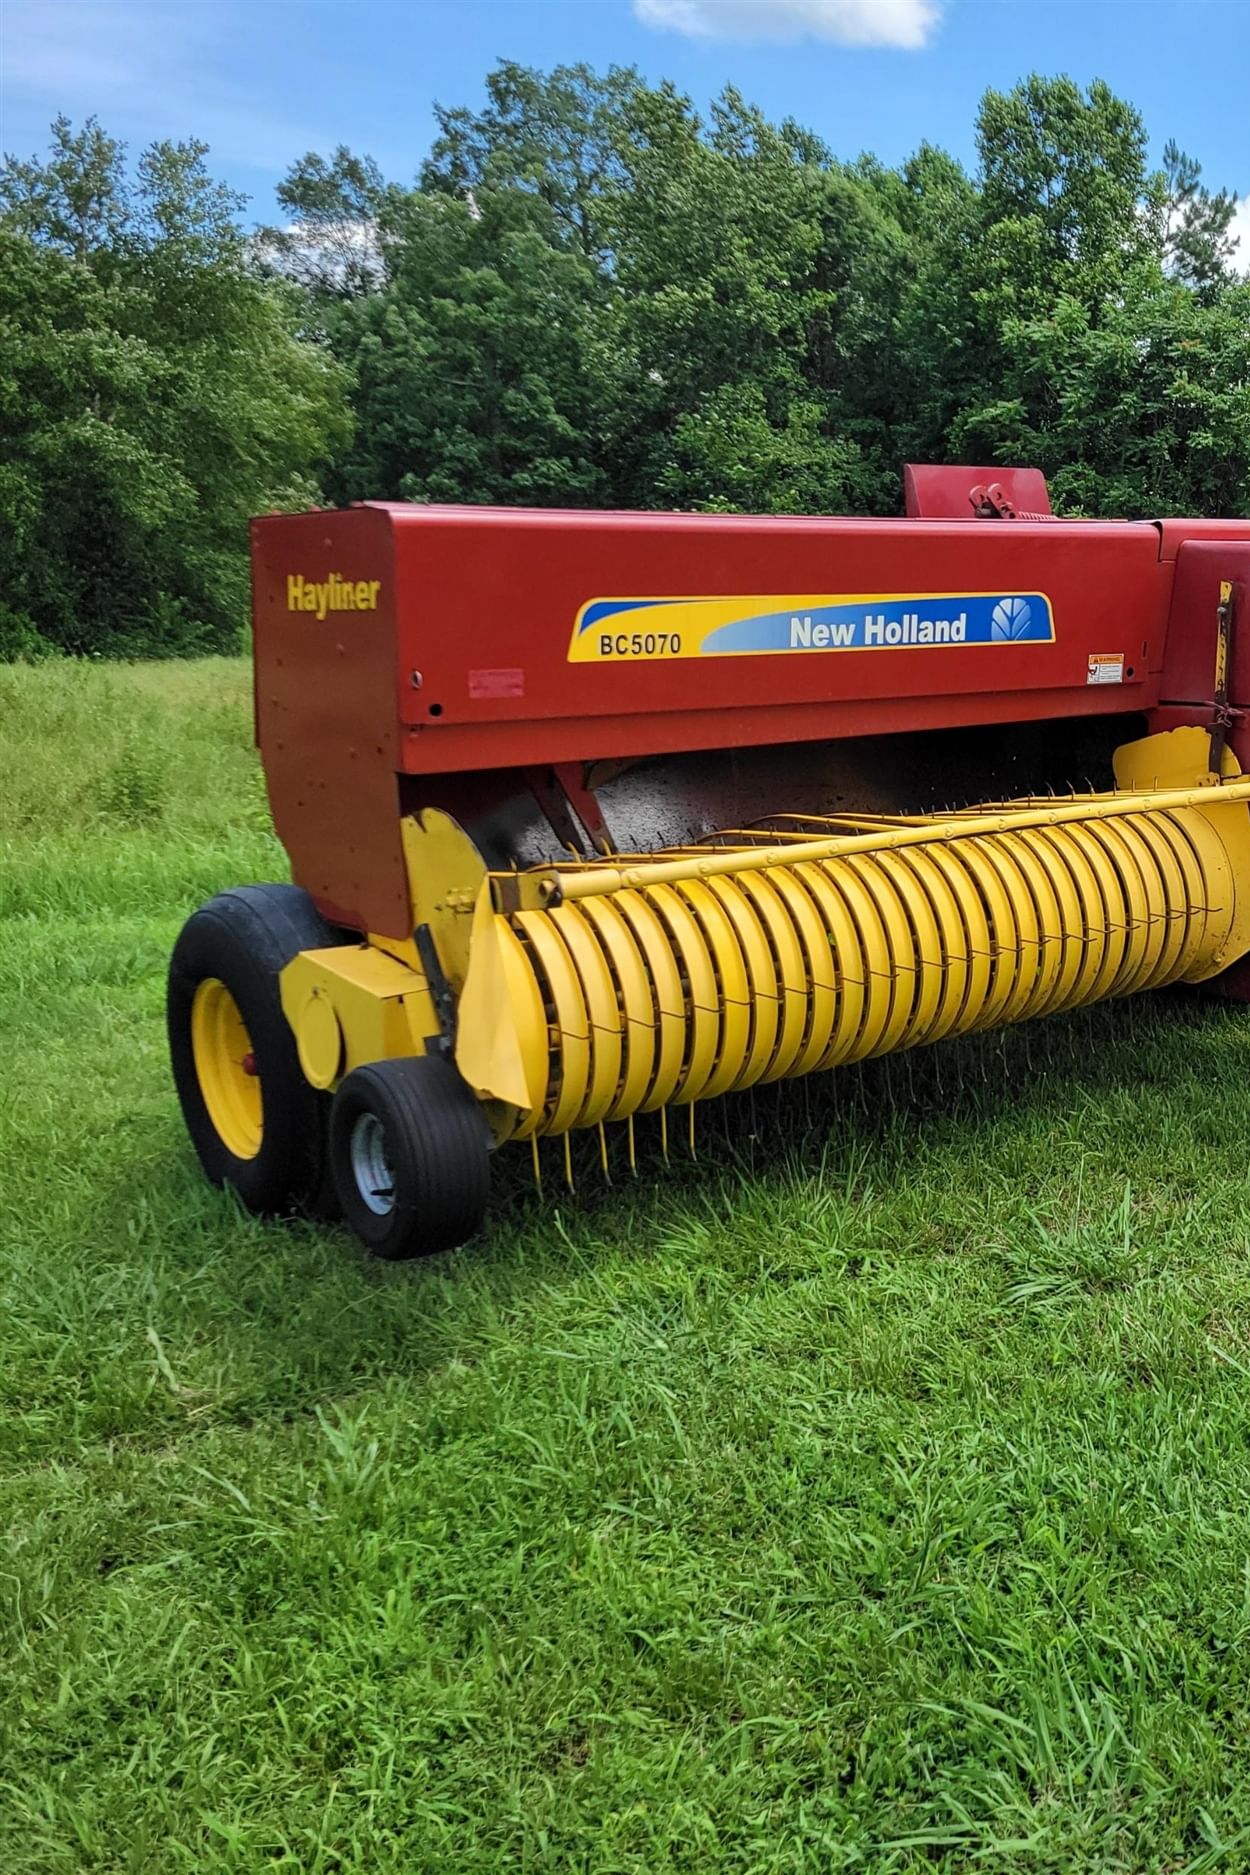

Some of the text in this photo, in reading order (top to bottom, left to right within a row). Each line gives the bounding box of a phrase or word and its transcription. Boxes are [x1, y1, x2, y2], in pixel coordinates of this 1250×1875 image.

[287, 572, 380, 620] Hayliner
[600, 634, 681, 655] BC5070
[790, 613, 966, 647] New Holland
